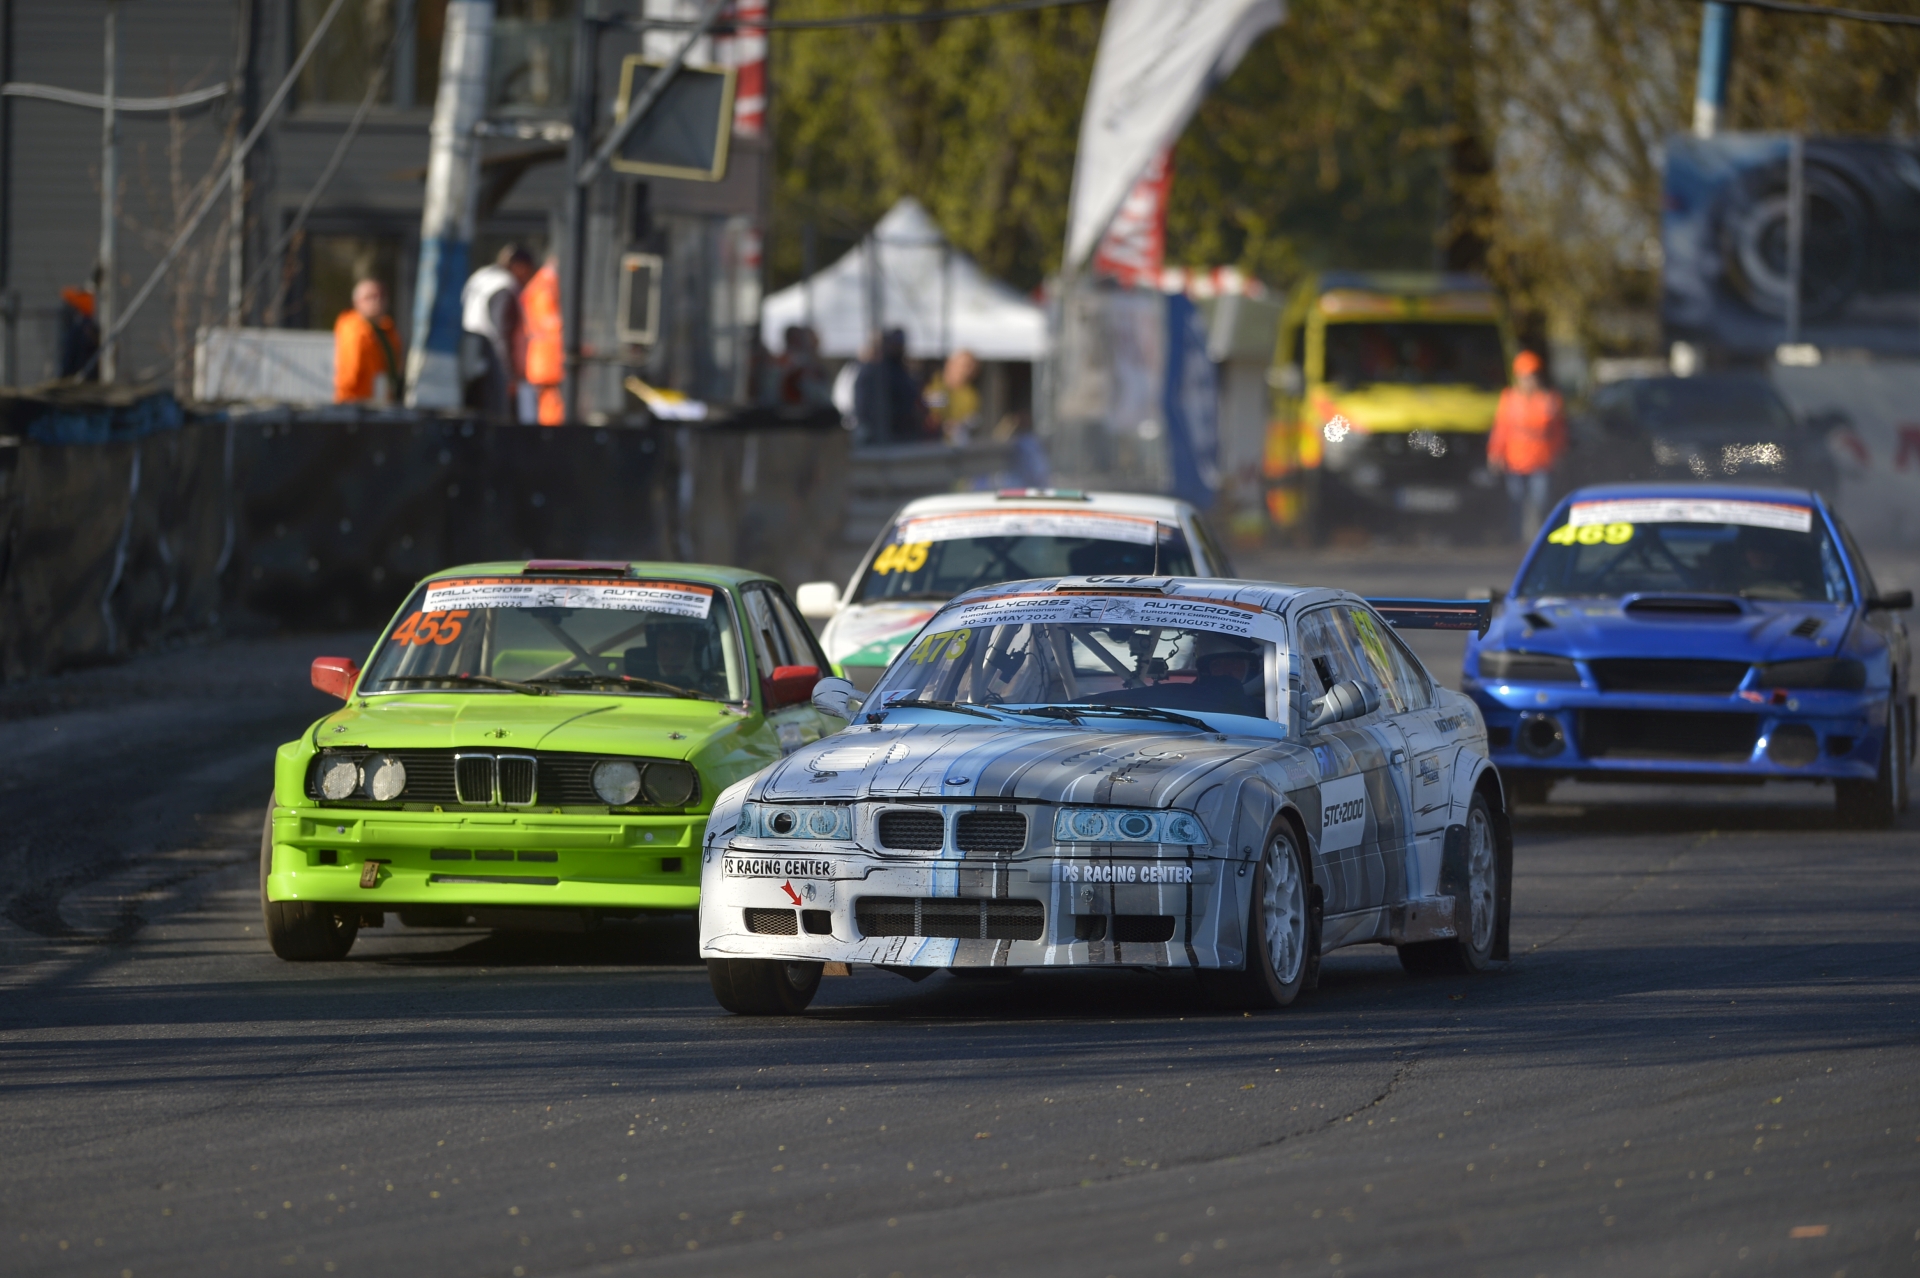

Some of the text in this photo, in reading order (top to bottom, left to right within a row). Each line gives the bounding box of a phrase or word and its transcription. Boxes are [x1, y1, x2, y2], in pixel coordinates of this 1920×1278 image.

[1548, 521, 1634, 545] 469
[873, 541, 933, 576] 445
[431, 587, 533, 598] RALLYCROSS
[603, 589, 706, 603] AUTOCROSS
[629, 605, 673, 613] AUGUST
[676, 608, 703, 618] 2026
[963, 600, 1071, 613] RALLYCROSS
[1143, 602, 1254, 620] AUTOCROSS
[960, 611, 1003, 619] EUROPEAN
[961, 617, 993, 626] 30-31
[1187, 613, 1251, 625] CHAMPIONSHIP
[391, 610, 470, 646] 455
[1169, 618, 1216, 628] AUGUST
[1219, 623, 1248, 633] 2026
[909, 628, 971, 665] 473
[724, 859, 831, 876] PS RACING CENTER
[1062, 865, 1193, 883] PS RACING CENTER
